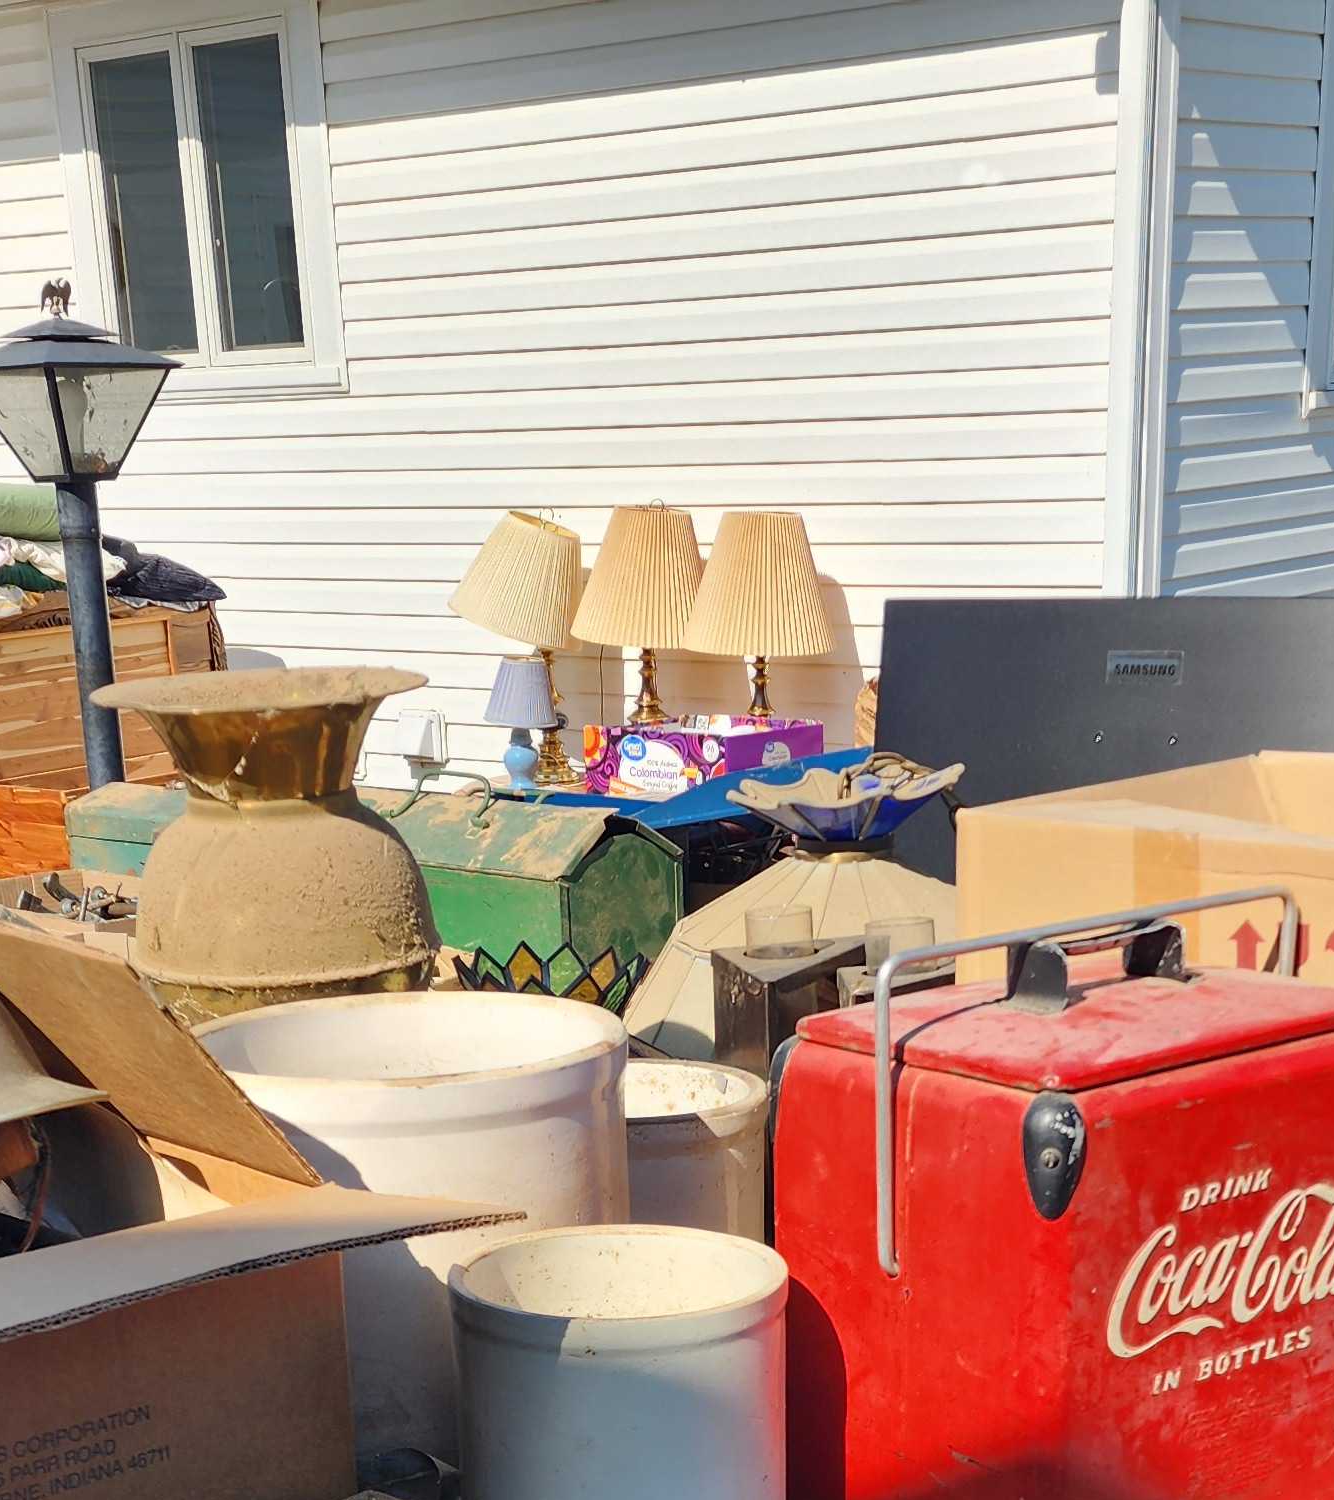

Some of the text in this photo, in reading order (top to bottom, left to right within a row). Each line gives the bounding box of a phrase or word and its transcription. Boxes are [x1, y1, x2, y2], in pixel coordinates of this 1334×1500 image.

[1114, 663, 1176, 676] SAMSUNG
[629, 766, 678, 779] Colombian
[1180, 1167, 1273, 1213] DRINK
[1151, 1325, 1314, 1396] IN BOTTLES
[13, 1405, 151, 1458] CORPORATION
[9, 1455, 60, 1482] PARR
[64, 1439, 116, 1466] ROAD
[50, 1460, 123, 1494] INDIANA
